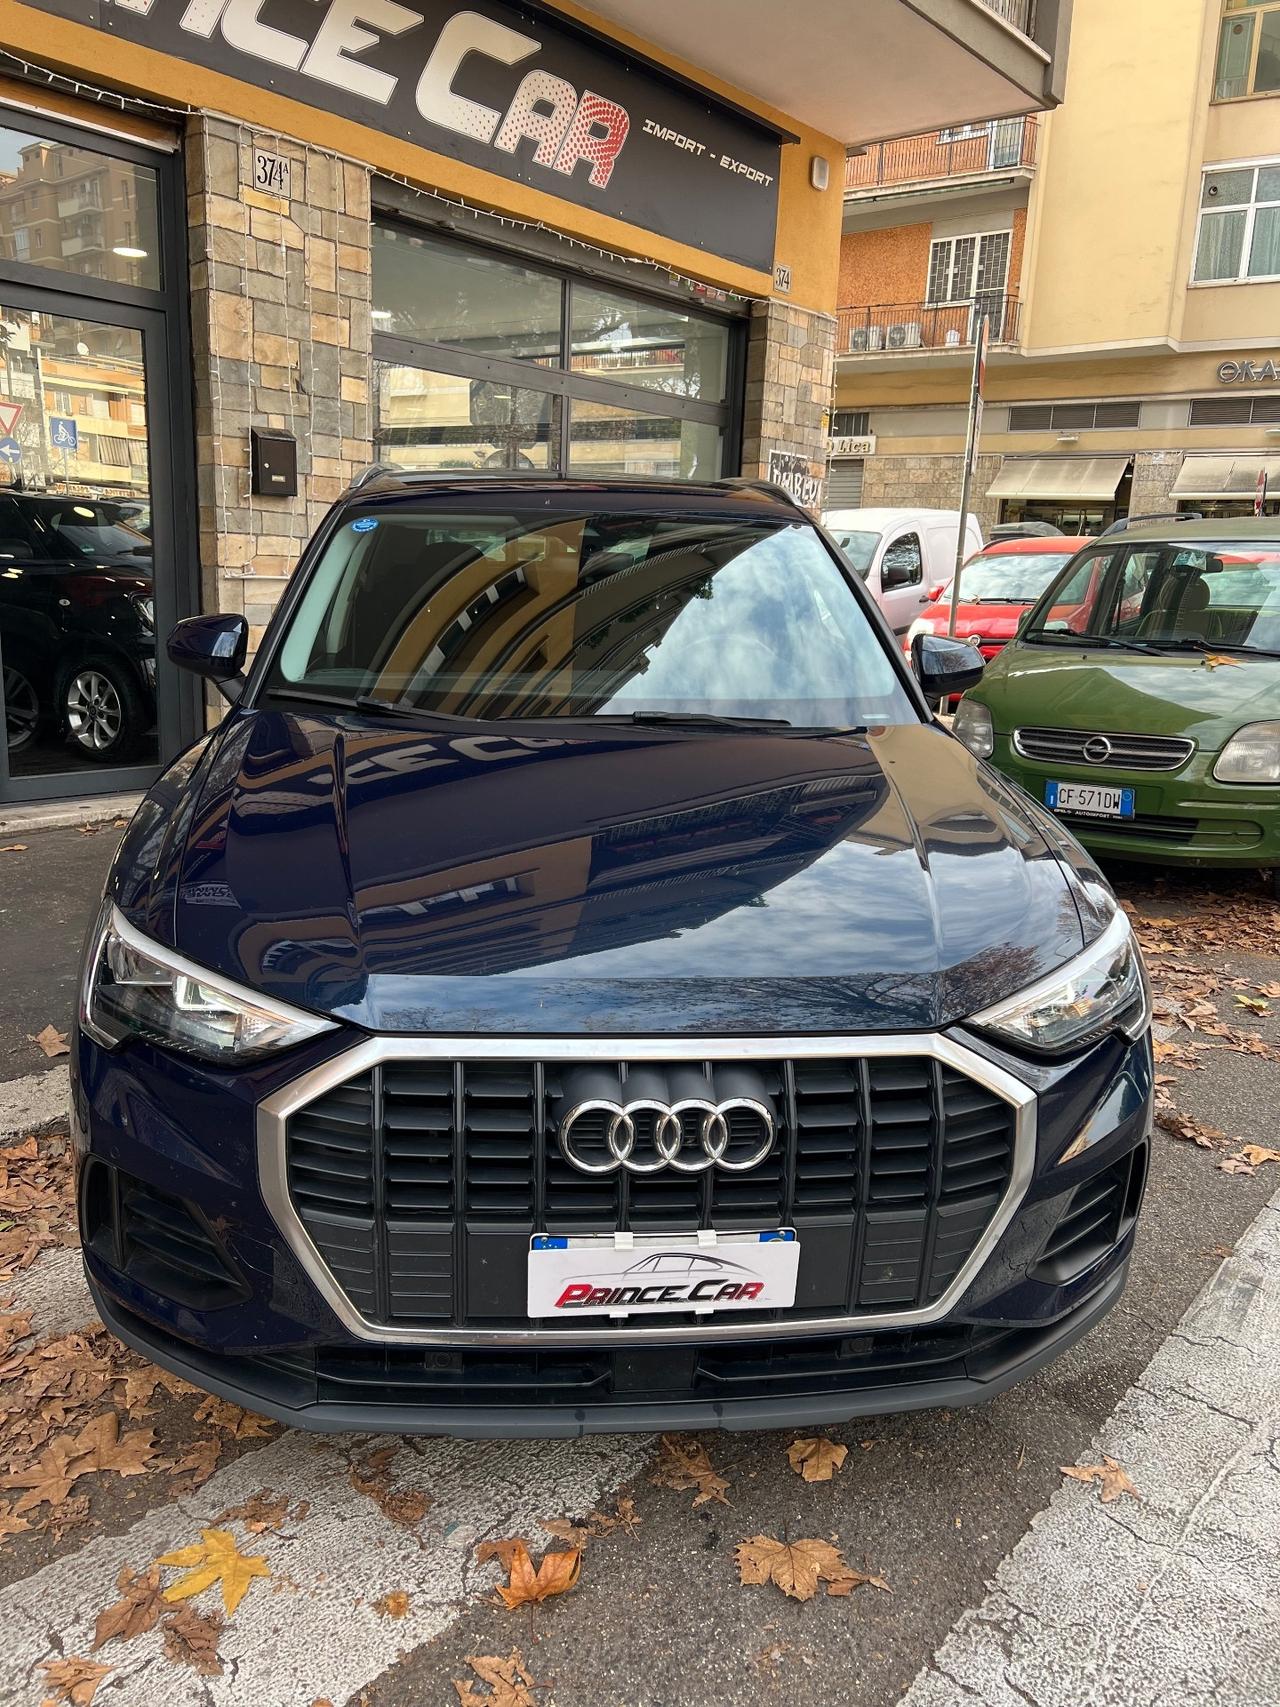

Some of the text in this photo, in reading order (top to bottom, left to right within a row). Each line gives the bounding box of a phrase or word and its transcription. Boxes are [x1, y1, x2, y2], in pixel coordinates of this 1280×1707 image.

[415, 11, 630, 190] CAR
[642, 119, 706, 156] IMPORT
[719, 155, 773, 187] EXPORT
[776, 267, 790, 290] 374
[838, 438, 870, 454] Lica
[554, 1278, 766, 1308] PRINCE CAR
